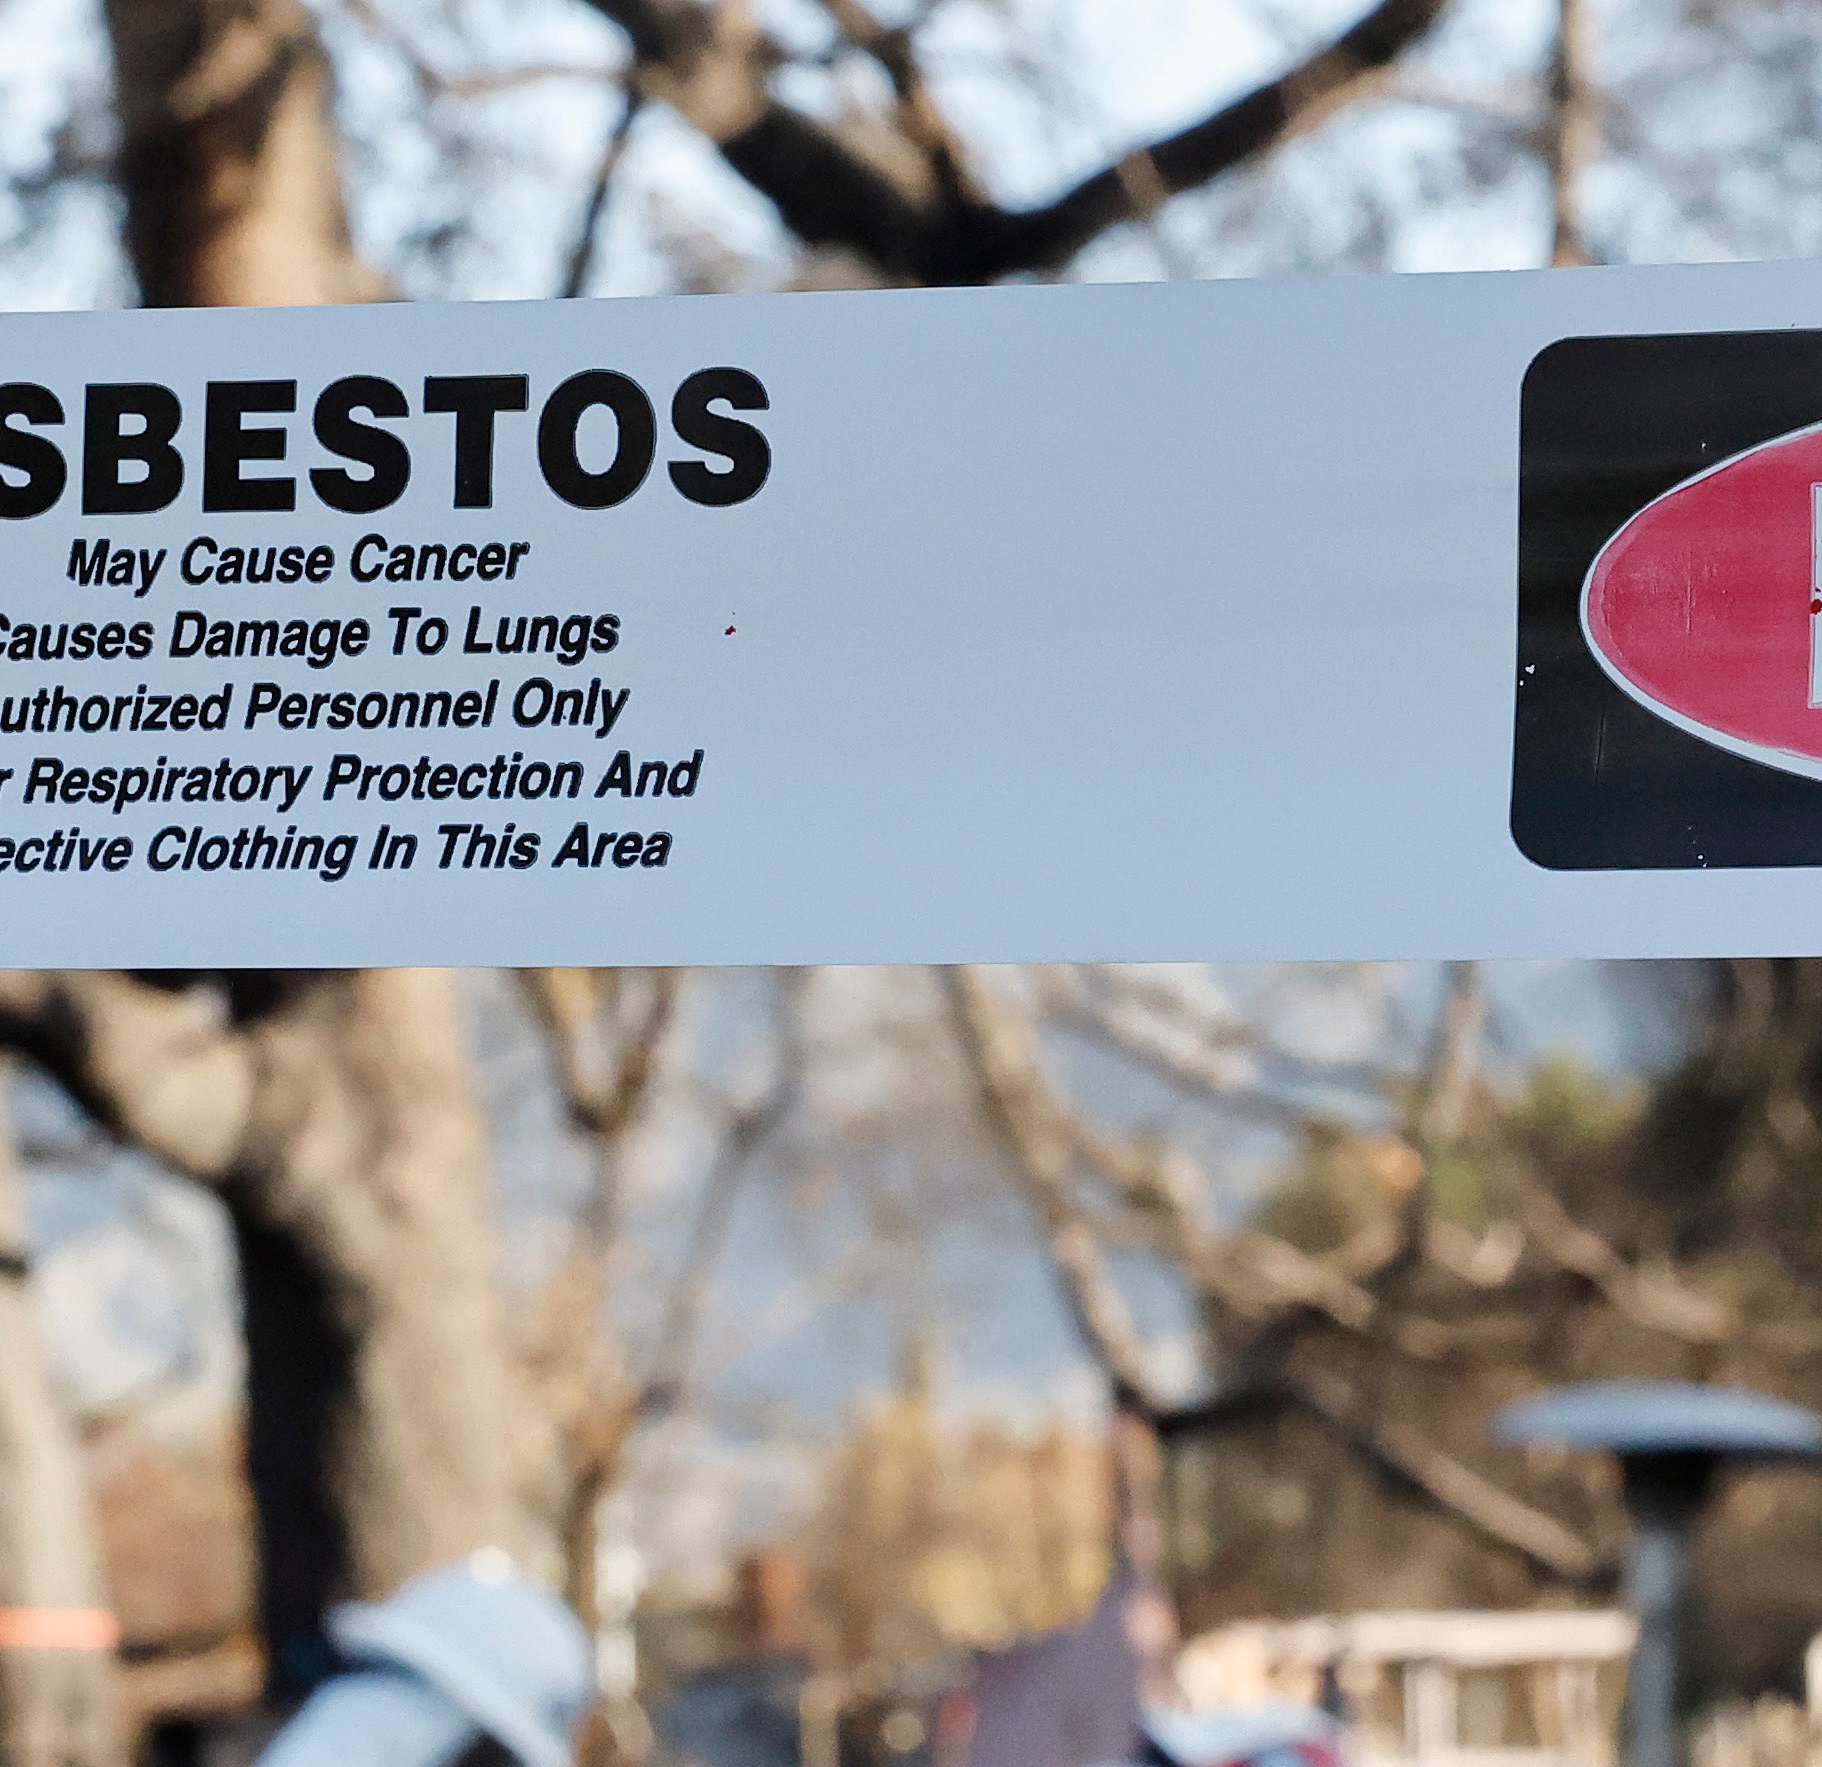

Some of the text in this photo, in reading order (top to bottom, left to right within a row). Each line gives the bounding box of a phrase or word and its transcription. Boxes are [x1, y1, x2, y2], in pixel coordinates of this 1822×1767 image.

[66, 533, 531, 599] May Cause Cancer
[168, 610, 371, 670] Damage
[387, 607, 449, 656] To
[462, 608, 621, 667] Lungs
[243, 679, 500, 731] Personnel
[512, 677, 632, 739] Only
[22, 754, 314, 814] Respiratory
[322, 750, 585, 801] Protection
[593, 750, 705, 799] And
[146, 825, 359, 883] Clothing
[367, 824, 418, 870] In
[435, 823, 541, 870] This
[551, 821, 674, 870] Area
